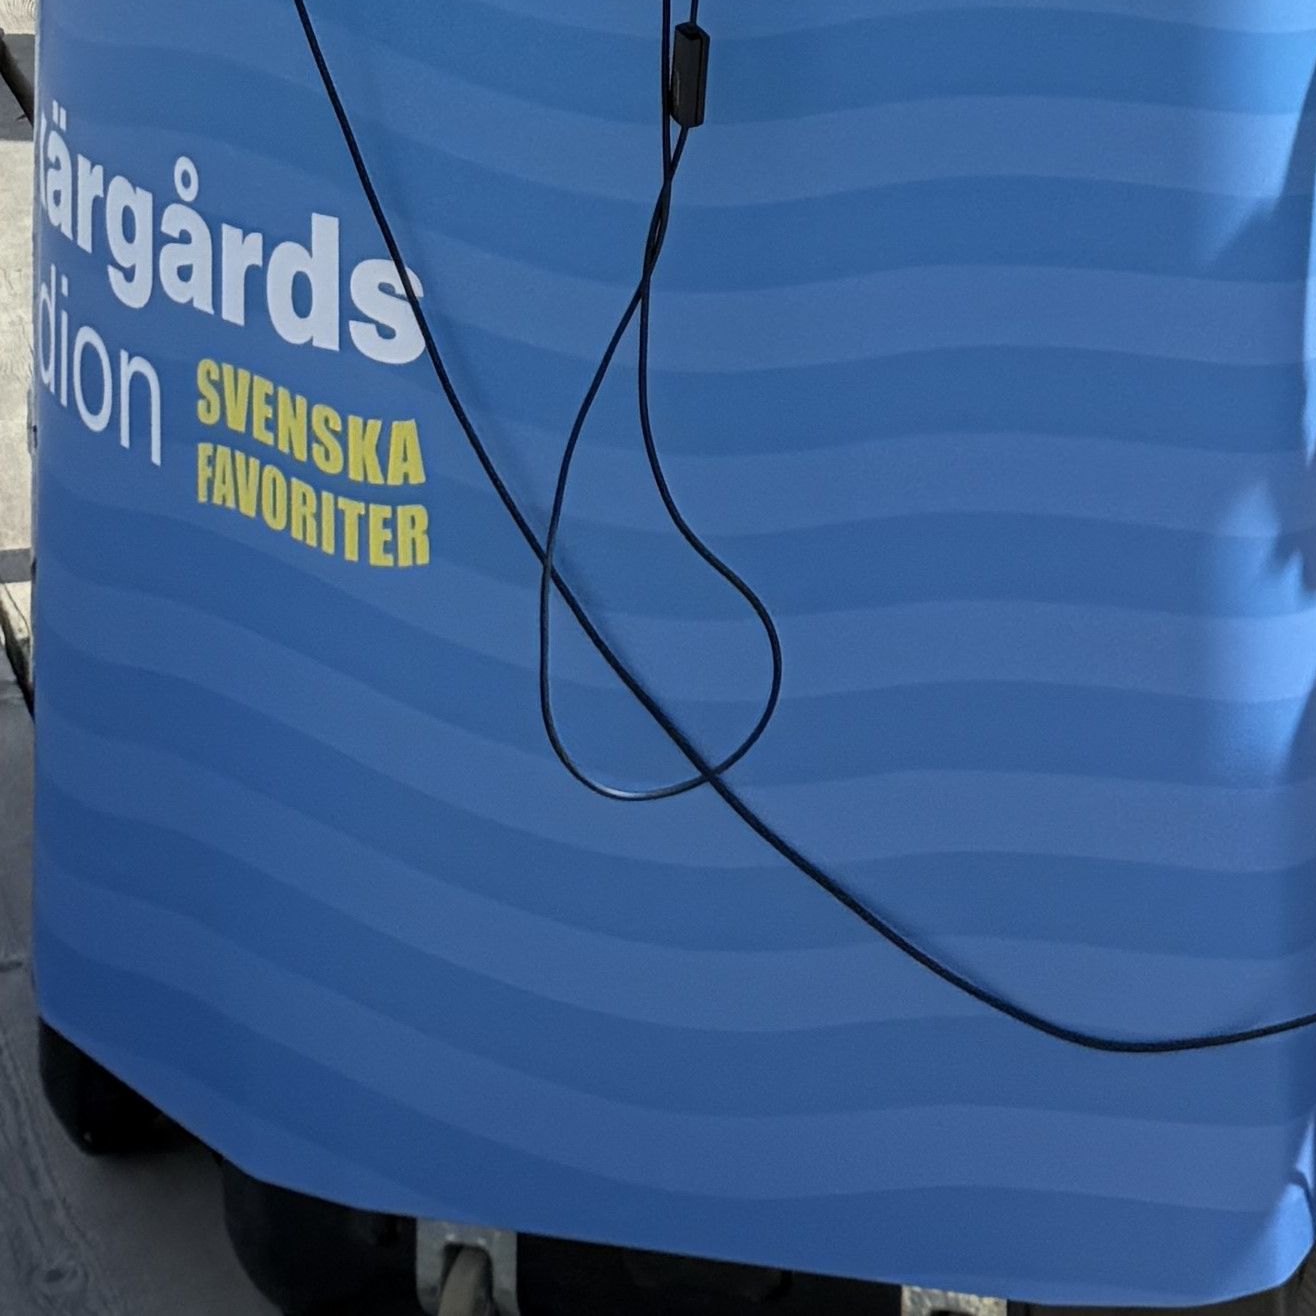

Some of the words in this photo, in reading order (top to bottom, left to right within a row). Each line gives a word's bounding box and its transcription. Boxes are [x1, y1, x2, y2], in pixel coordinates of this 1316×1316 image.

[40, 101, 427, 365] ärgårds
[37, 264, 162, 467] dion
[196, 357, 426, 486] SVENSKA
[196, 442, 430, 568] FAVORITER
